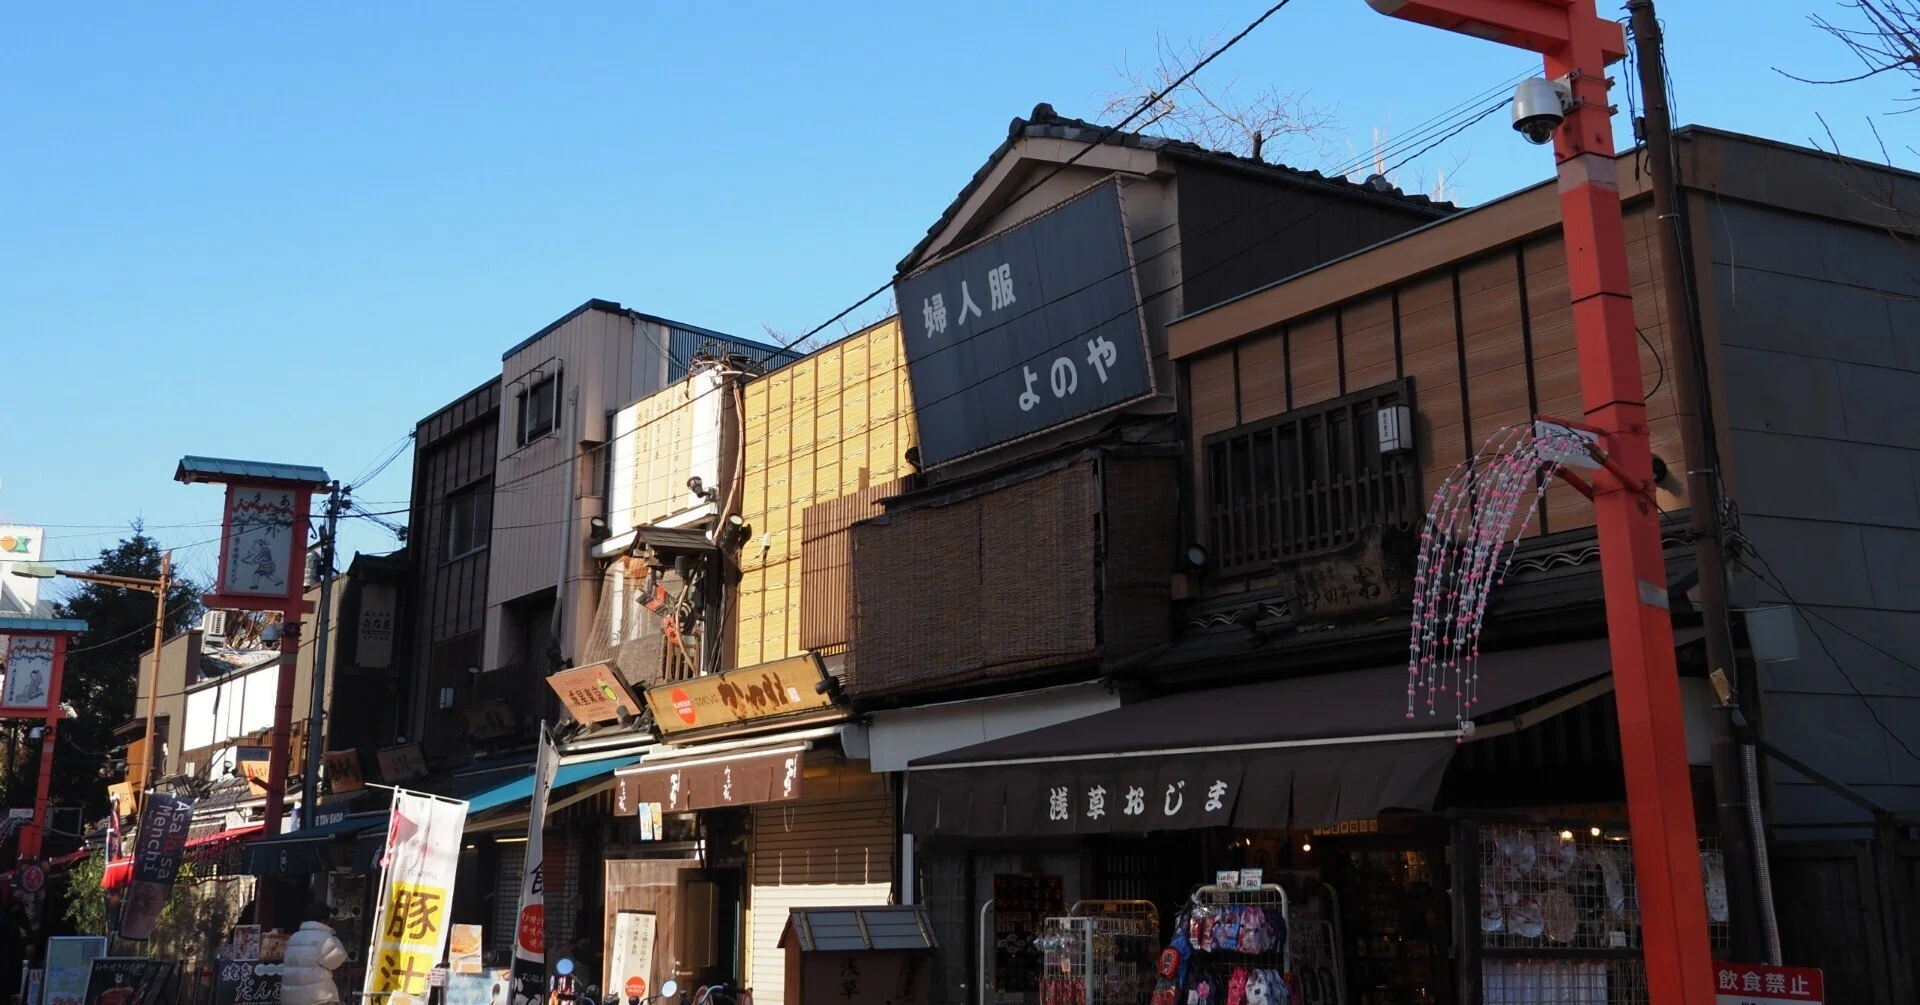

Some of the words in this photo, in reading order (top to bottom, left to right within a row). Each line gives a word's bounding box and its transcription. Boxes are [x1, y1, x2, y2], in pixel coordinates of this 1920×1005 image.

[922, 262, 1017, 338] 婦人服
[1018, 335, 1117, 412] よのや
[1049, 779, 1229, 821] 浅草おじま
[143, 804, 174, 873] Menchi
[222, 963, 253, 981] 焼き
[381, 889, 441, 996] 豚汁
[1718, 969, 1811, 996] 飲食禁止
